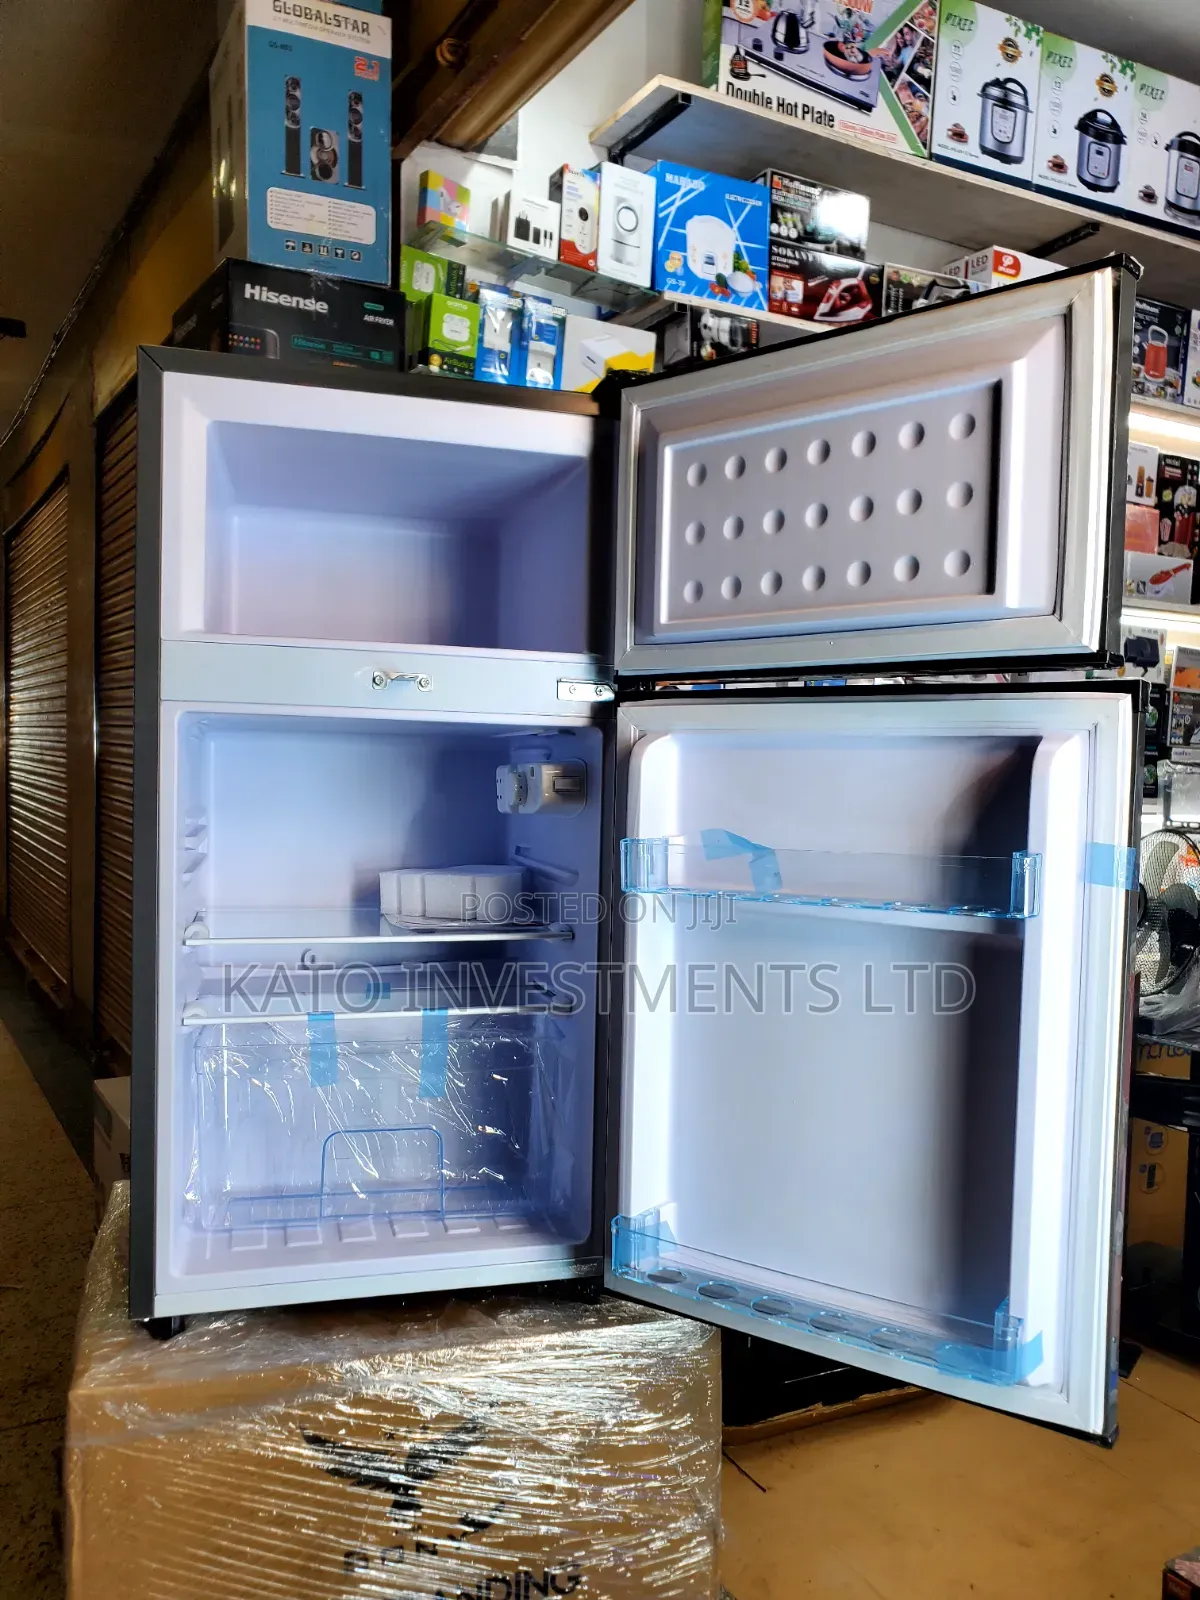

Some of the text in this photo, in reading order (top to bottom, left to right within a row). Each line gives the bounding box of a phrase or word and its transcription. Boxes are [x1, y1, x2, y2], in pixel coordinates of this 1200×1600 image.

[777, 95, 799, 120] Hot
[802, 103, 835, 129] Plate
[971, 255, 988, 269] LED
[244, 283, 329, 314] Hisense
